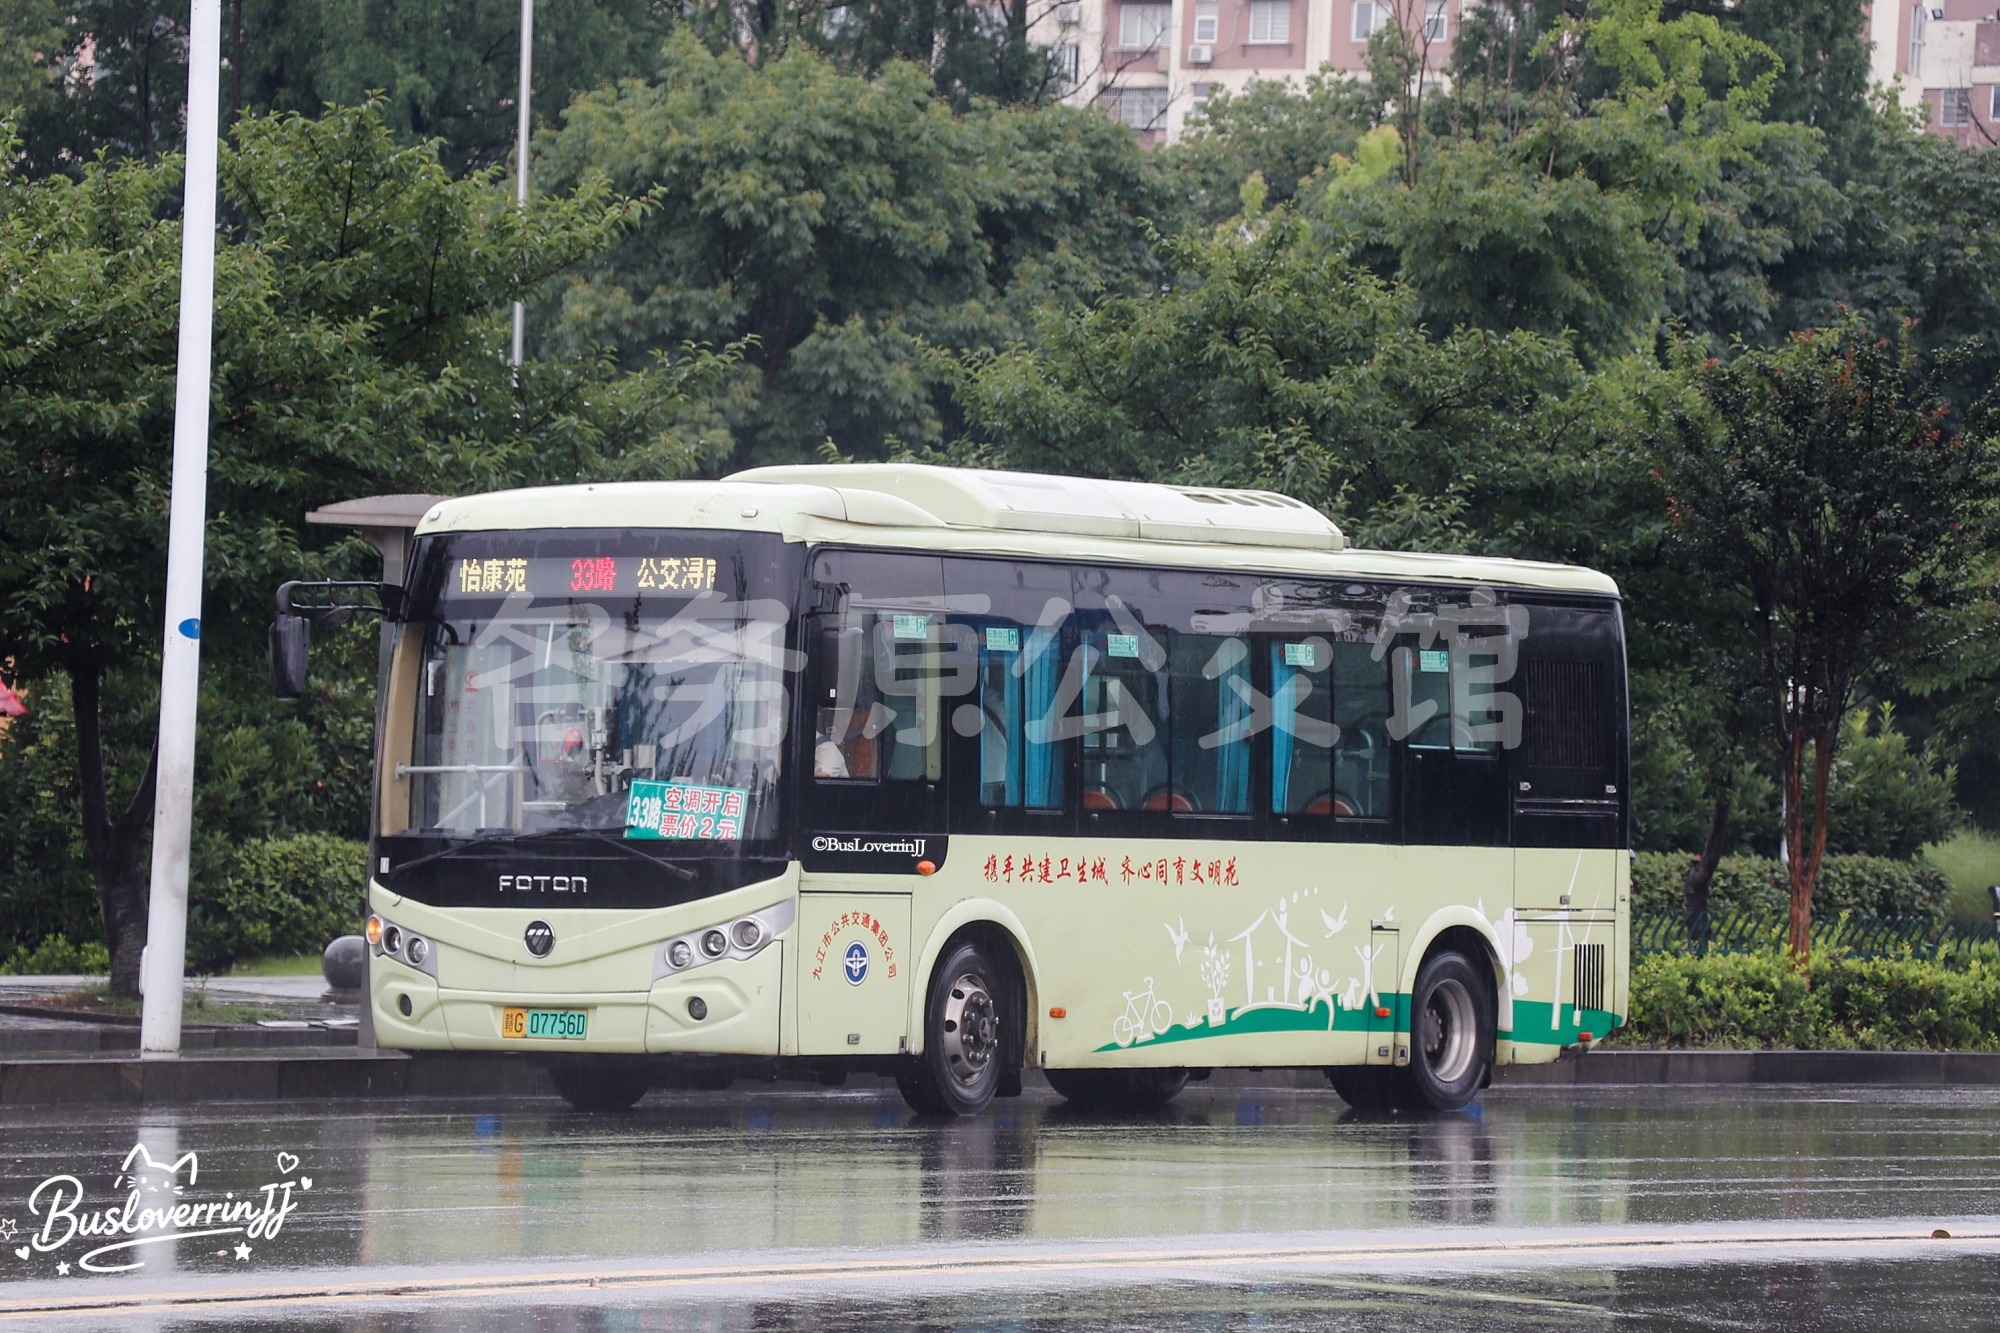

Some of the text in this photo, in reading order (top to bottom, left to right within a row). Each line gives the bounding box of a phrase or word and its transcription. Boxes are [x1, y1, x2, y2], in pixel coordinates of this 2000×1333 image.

[460, 558, 528, 593] 怡康苑
[570, 556, 617, 592] 33路
[630, 796, 662, 830] 33路
[664, 787, 742, 817] 空调开启
[658, 813, 738, 841] 票价2元
[498, 874, 588, 893] FOTON
[983, 852, 1240, 887] 携手共建卫生城 齐心同育文明花
[811, 910, 898, 982] 九江市公共交通集团公司
